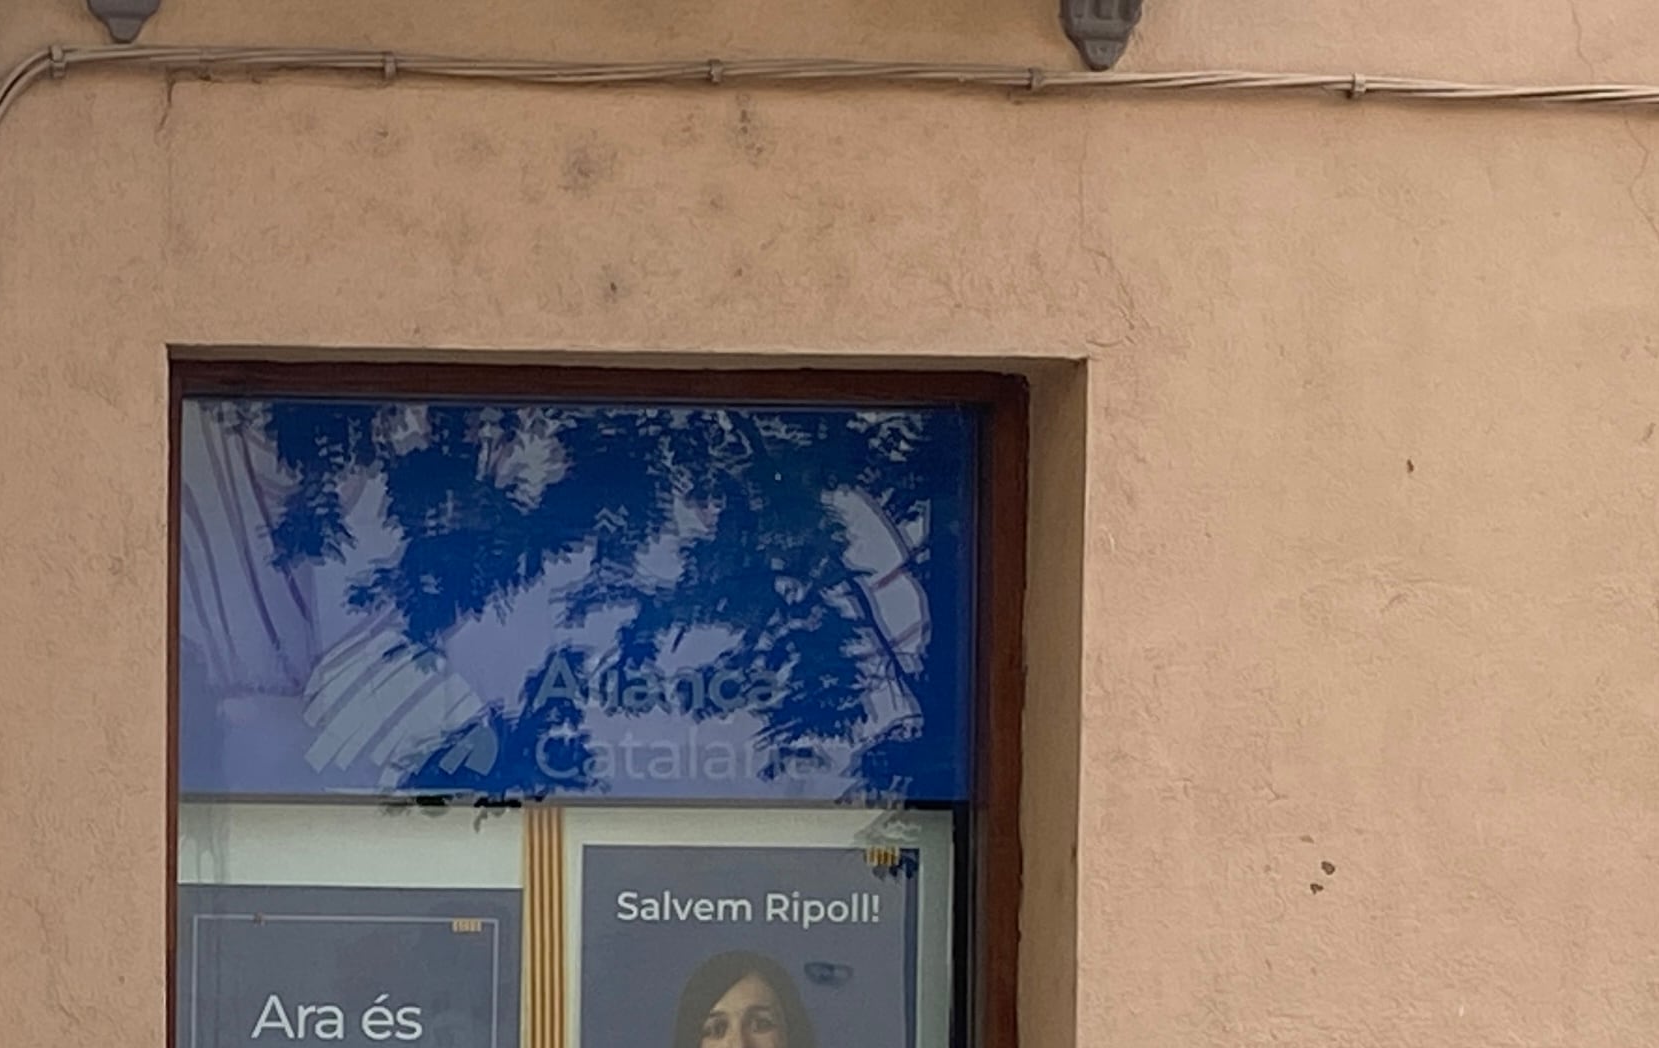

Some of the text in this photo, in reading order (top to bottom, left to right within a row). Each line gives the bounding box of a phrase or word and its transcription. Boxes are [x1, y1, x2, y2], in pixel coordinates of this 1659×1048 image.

[617, 891, 880, 928] Salvem Ripoll!
[251, 994, 423, 1040] Ara és
